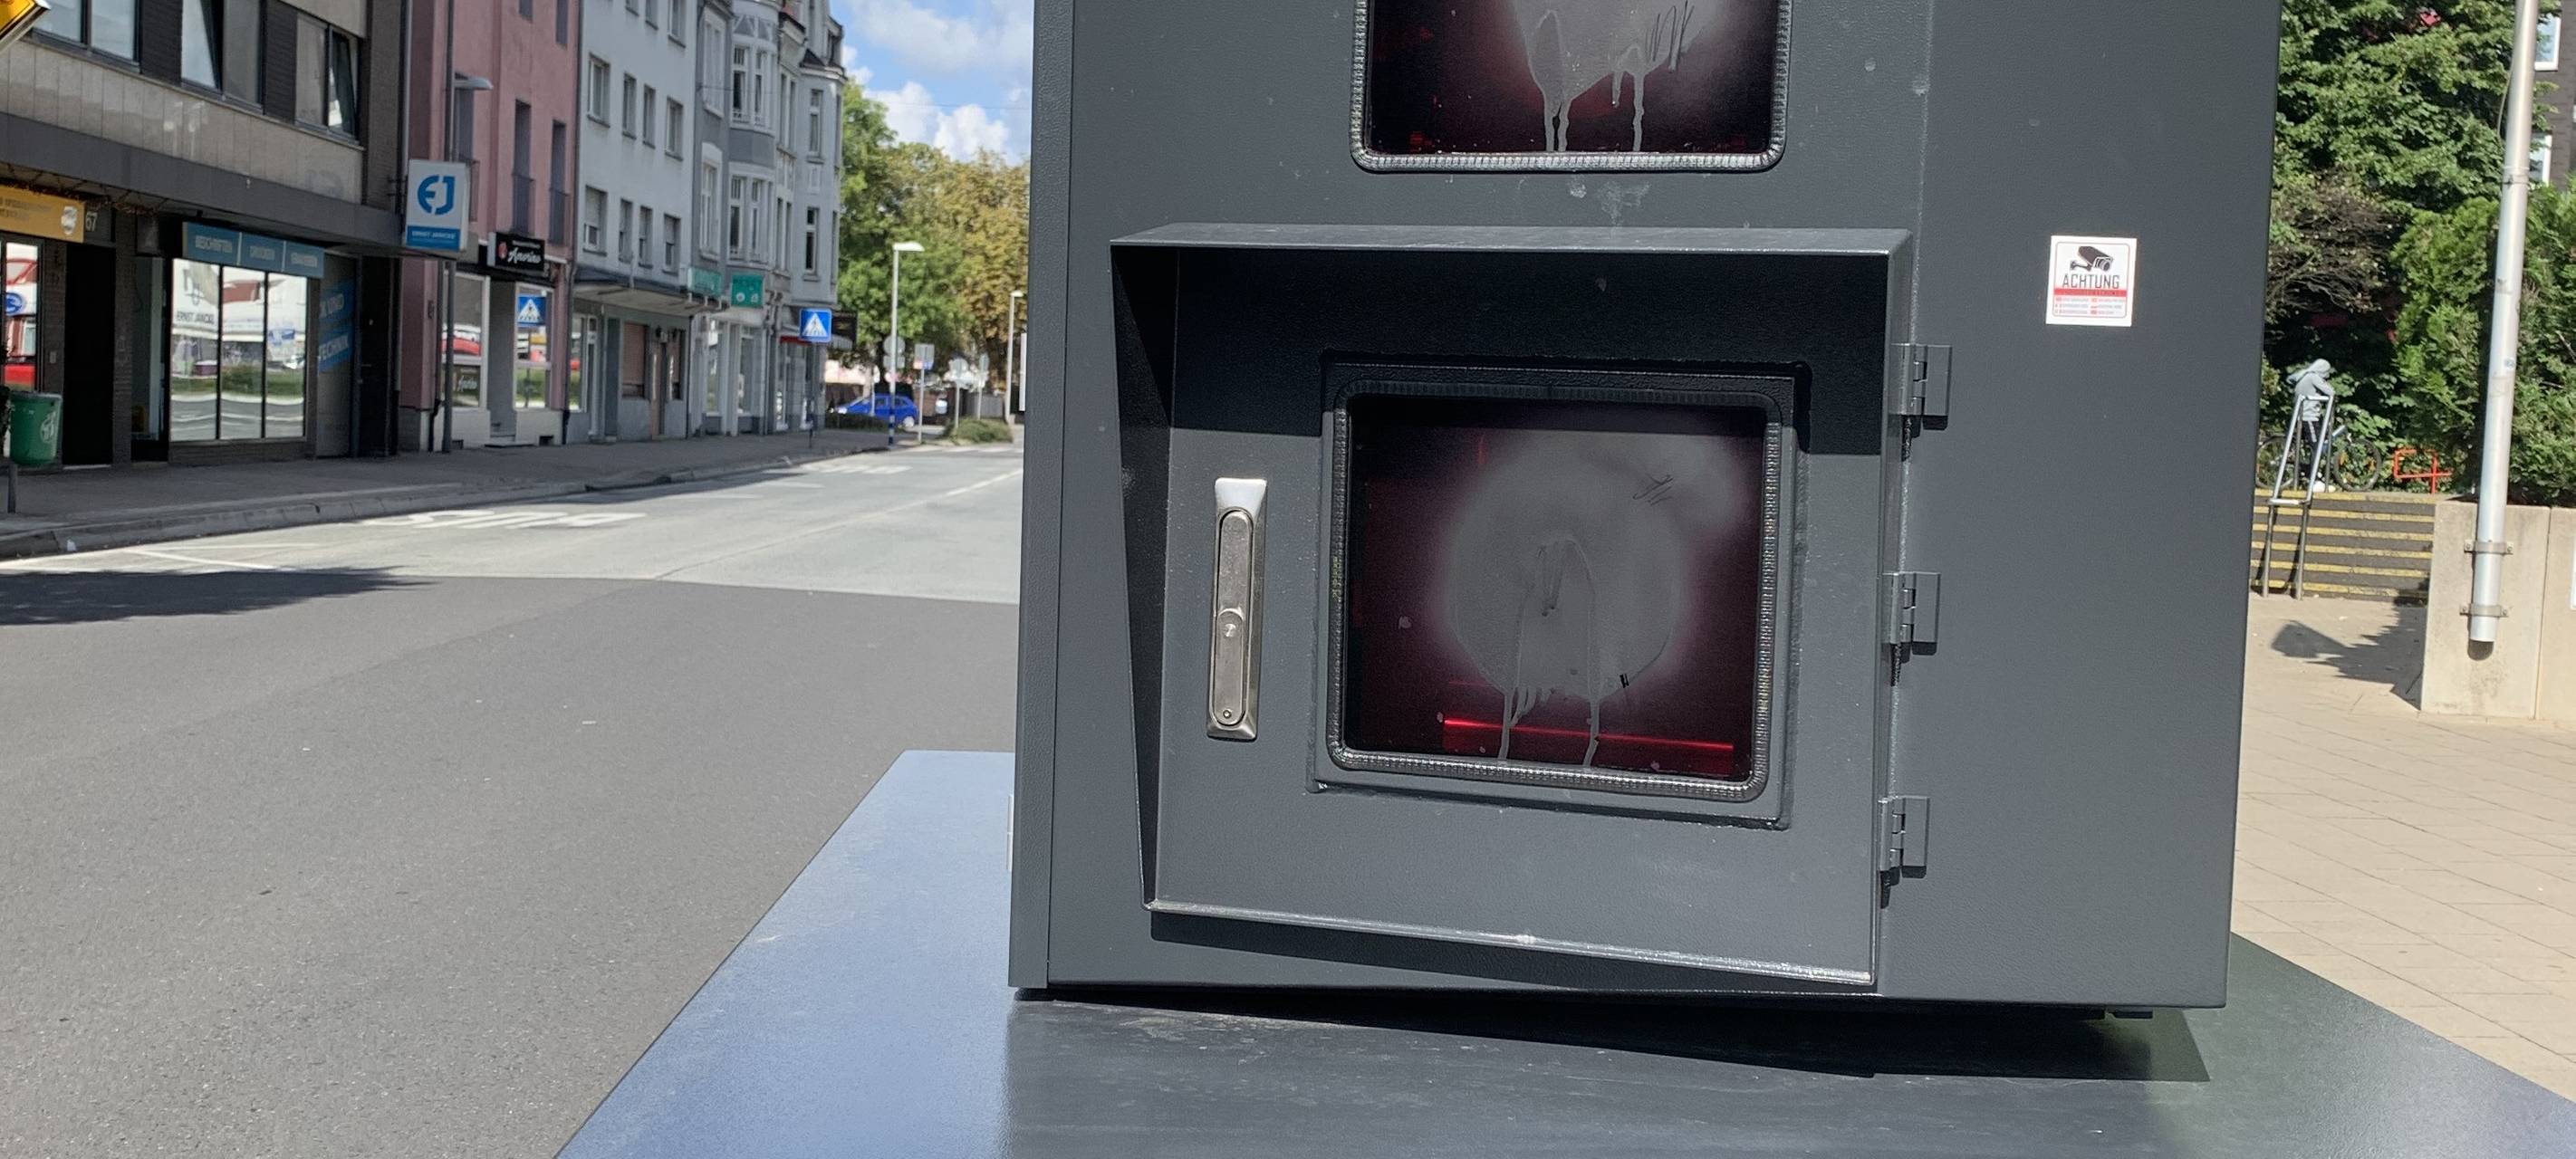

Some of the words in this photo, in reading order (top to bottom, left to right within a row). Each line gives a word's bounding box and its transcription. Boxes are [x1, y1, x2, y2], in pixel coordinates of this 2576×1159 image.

[418, 175, 456, 216] EJ
[85, 211, 98, 231] 67
[2062, 273, 2120, 290] ACHTUNG
